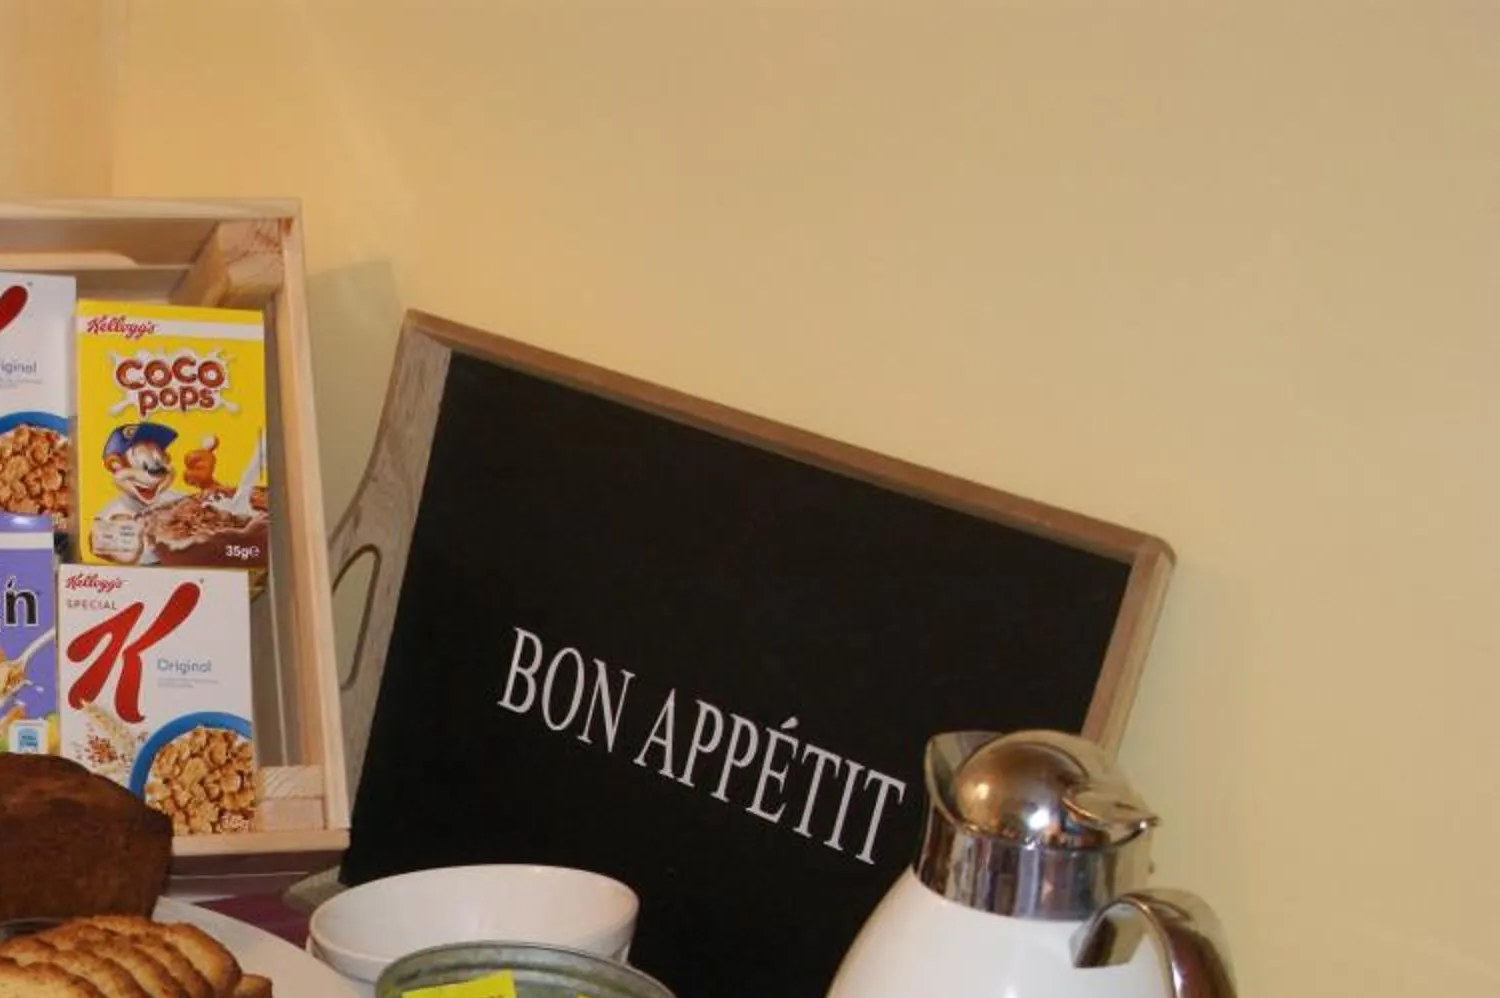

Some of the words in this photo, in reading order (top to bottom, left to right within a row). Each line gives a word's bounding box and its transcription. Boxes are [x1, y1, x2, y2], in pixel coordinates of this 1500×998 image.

[87, 315, 156, 338] Kellogg's
[116, 356, 225, 389] COCO
[65, 573, 124, 593] Kellogg's
[67, 599, 117, 610] SPECIAL
[67, 582, 200, 723] K
[157, 658, 211, 676] Original
[497, 627, 635, 753] BON
[633, 688, 906, 865] APPÉTIT
